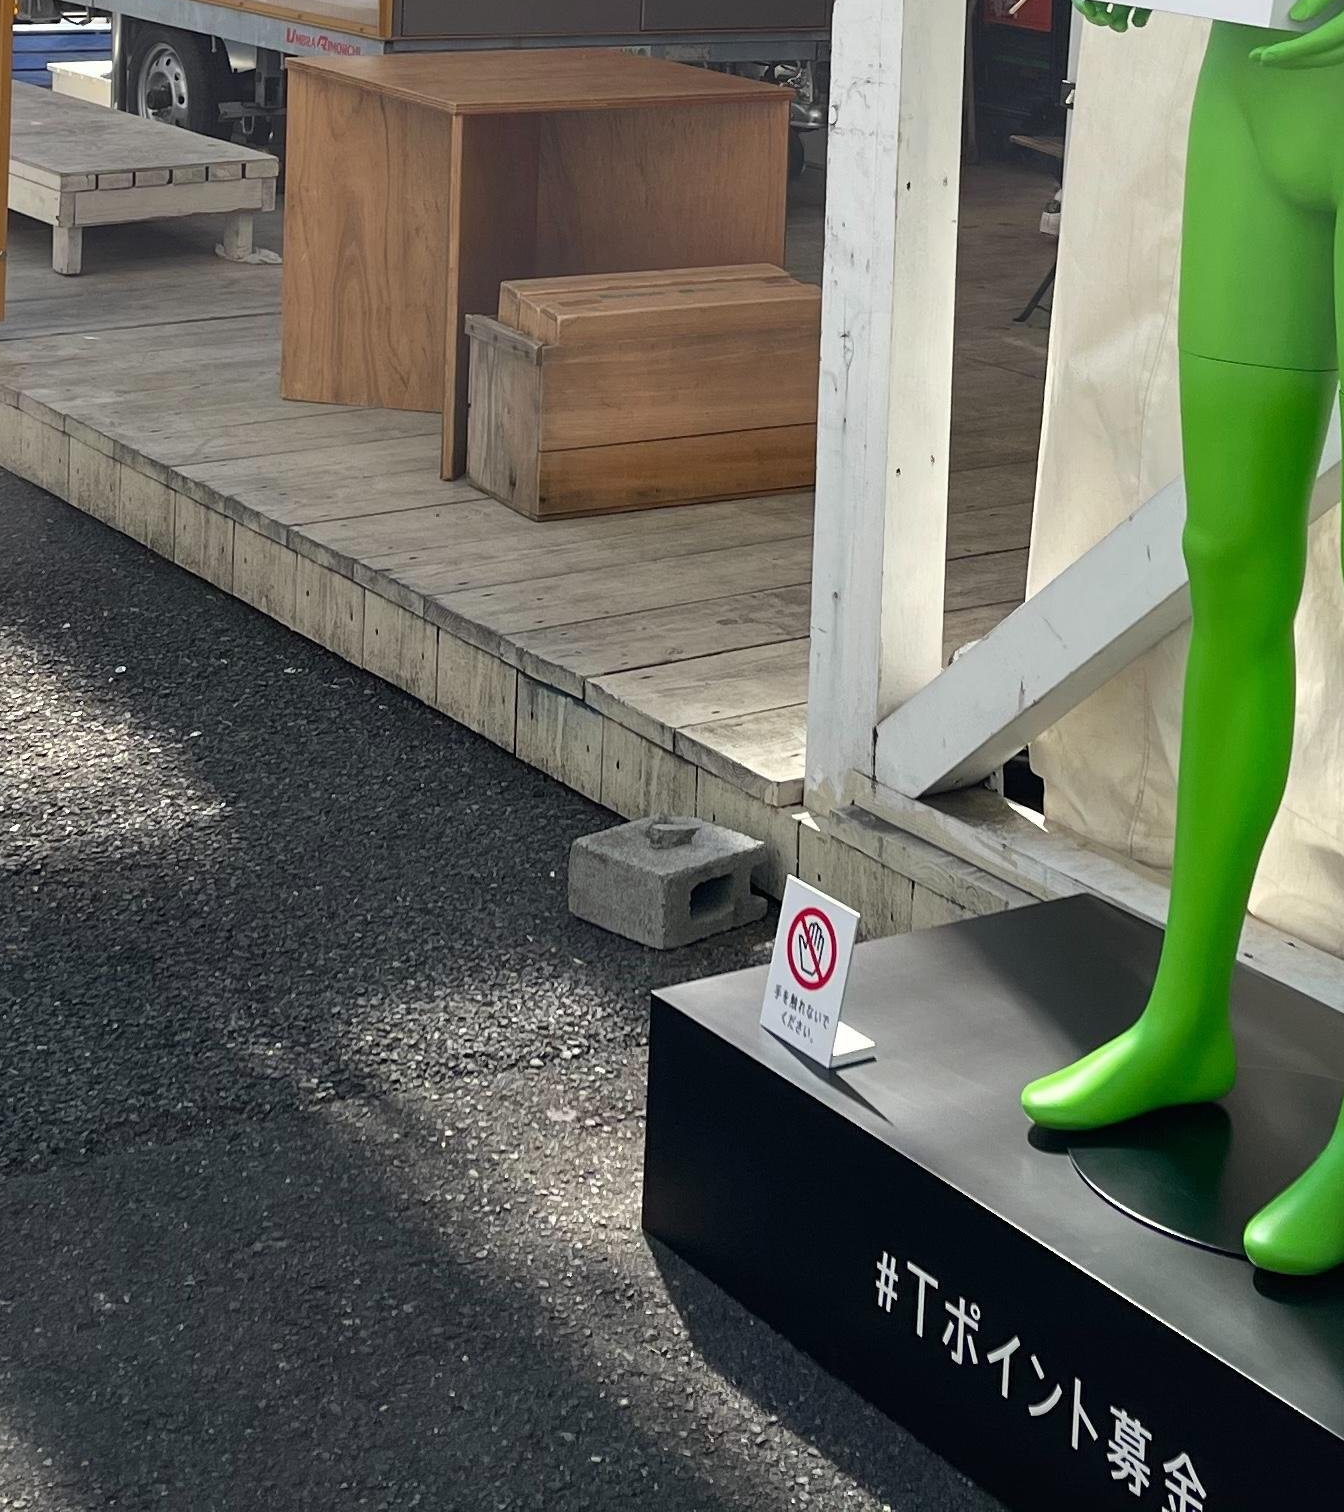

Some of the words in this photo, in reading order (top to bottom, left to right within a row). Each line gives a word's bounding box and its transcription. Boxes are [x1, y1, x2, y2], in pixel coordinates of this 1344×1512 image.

[774, 984, 830, 1030] 手を触れないで
[781, 1011, 814, 1044] ください。
[875, 1251, 1208, 1512] #Tポイント募金
